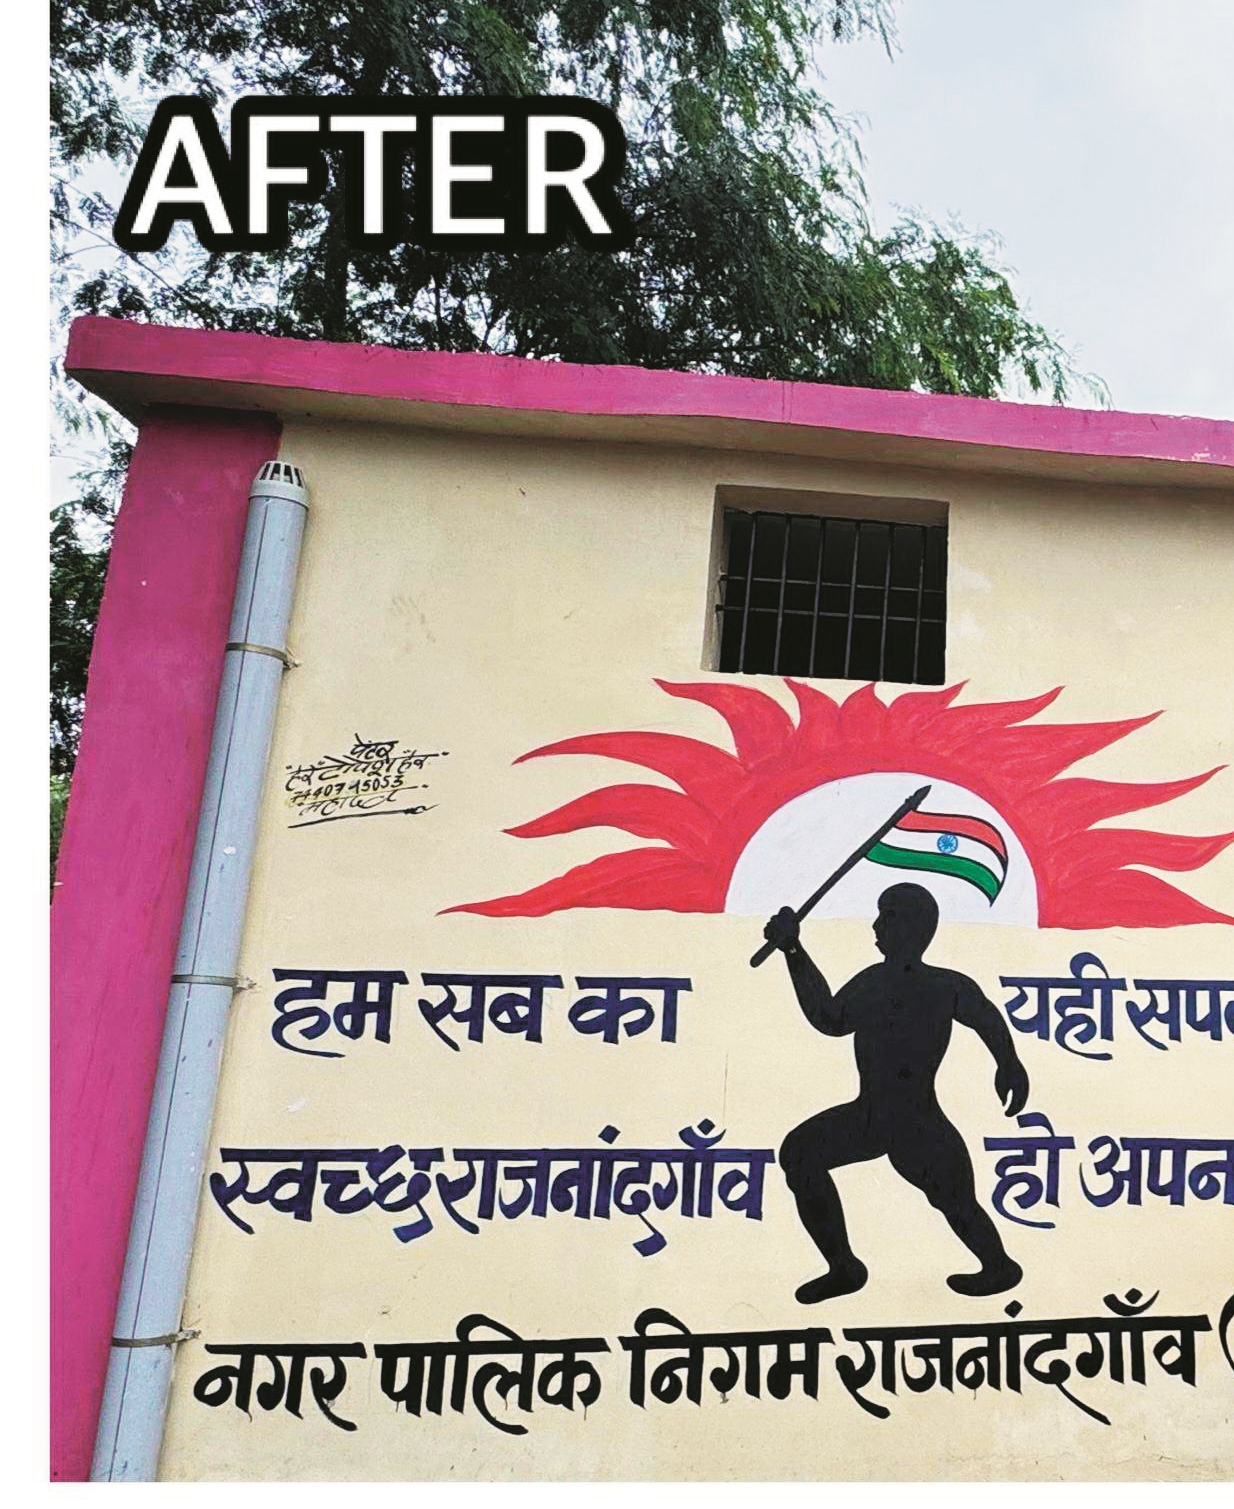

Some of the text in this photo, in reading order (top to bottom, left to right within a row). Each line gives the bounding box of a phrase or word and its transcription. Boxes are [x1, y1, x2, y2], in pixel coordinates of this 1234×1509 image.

[272, 968, 409, 1057] हम
[418, 972, 564, 1052] सब
[568, 976, 693, 1044] का
[999, 952, 1126, 1061] यही
[210, 1144, 444, 1243] स्वच्छ
[436, 1118, 776, 1257] राजनांदगाँव
[983, 1112, 1075, 1229] हो
[194, 1343, 367, 1431] नगर
[374, 1314, 611, 1435] पालिक
[618, 1308, 836, 1408] निगम
[836, 1288, 1212, 1425] राजनांदगाँव
